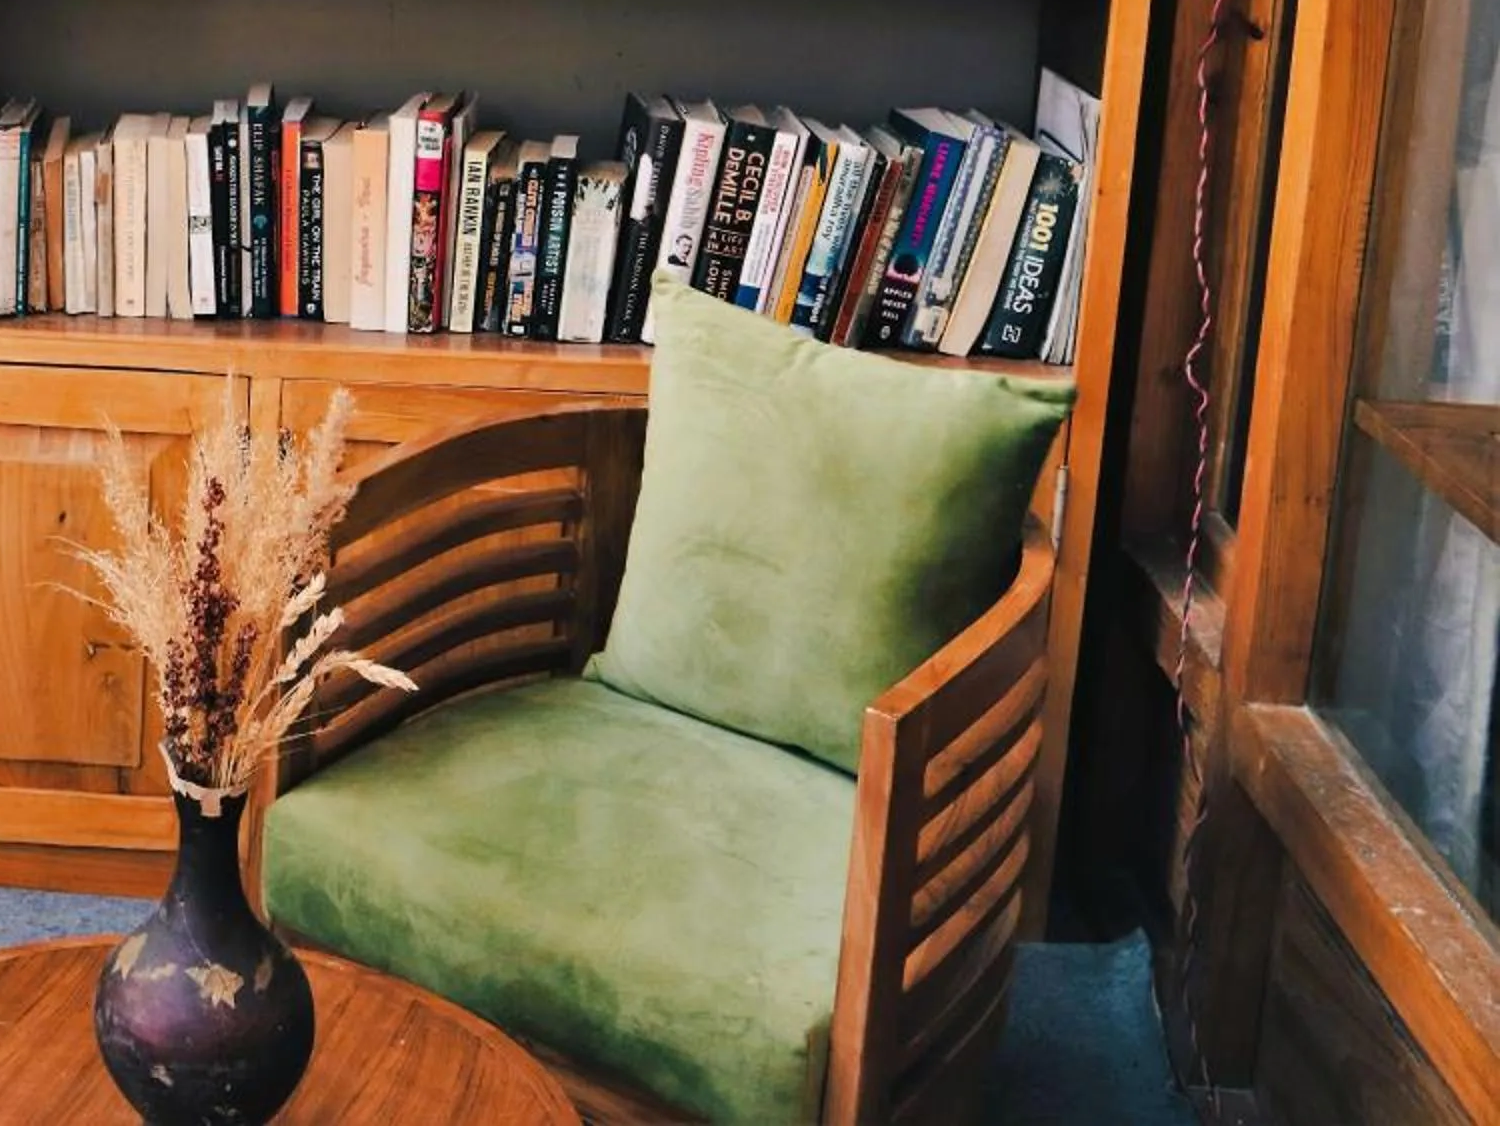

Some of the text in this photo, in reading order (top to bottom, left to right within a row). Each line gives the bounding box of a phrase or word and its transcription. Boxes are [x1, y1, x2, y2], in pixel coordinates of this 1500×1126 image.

[253, 156, 267, 206] SHAFAK
[680, 131, 716, 230] Kipling Sahib
[737, 150, 766, 205] CECIL
[847, 182, 860, 201] the
[301, 189, 311, 228] PAULA
[461, 161, 483, 237] IAN RANKIN
[548, 190, 568, 232] POISON
[820, 157, 854, 243] anuradha roy
[835, 202, 855, 232] lives
[311, 173, 322, 302] THE GIRL ON THE TRAIN
[544, 234, 565, 276] ARTIST
[635, 231, 649, 251] THE
[1011, 201, 1060, 316] 1001 IDEAS
[630, 252, 646, 291] INDIAN
[704, 258, 722, 296] LOUV
